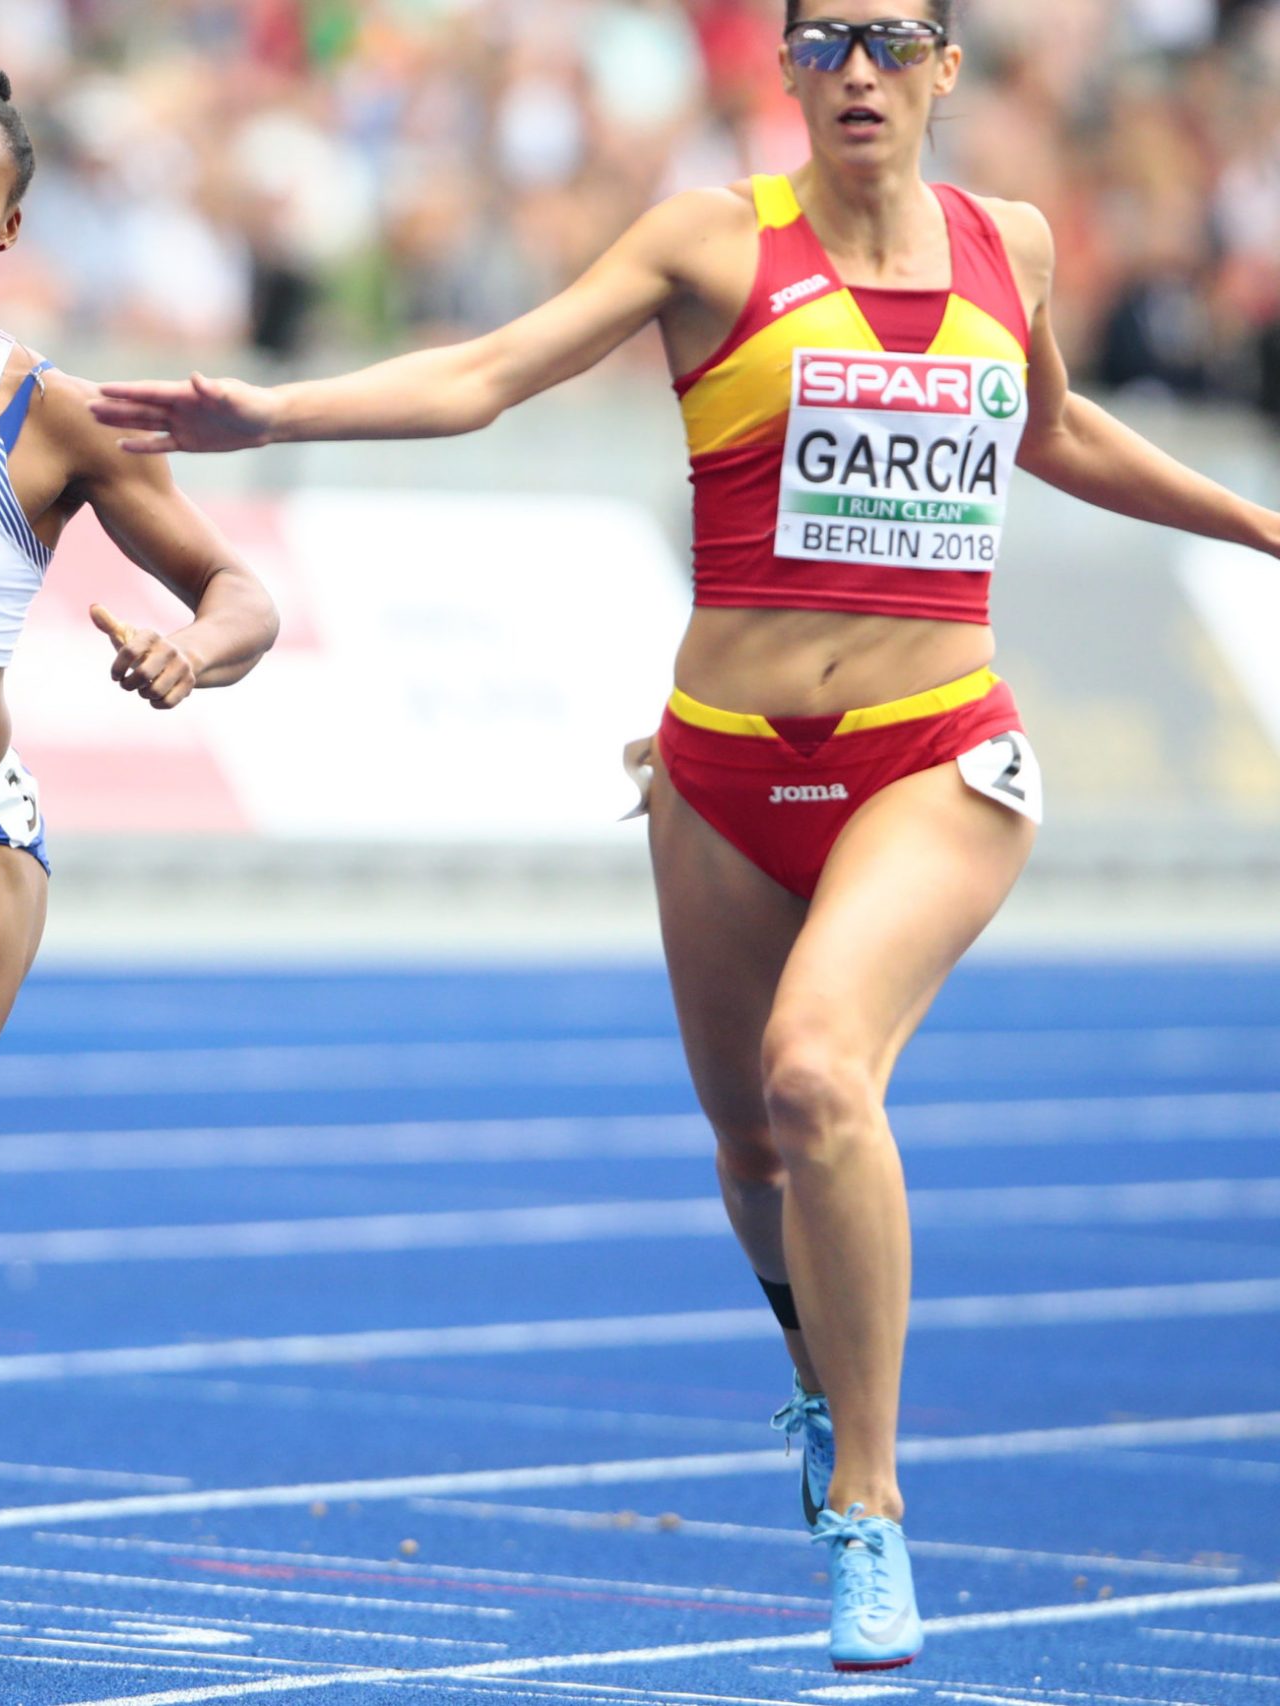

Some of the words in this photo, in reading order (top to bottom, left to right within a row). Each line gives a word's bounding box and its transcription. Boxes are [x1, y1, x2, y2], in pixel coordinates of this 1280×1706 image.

[803, 361, 969, 408] SPAR
[797, 425, 998, 496] GARCÍA
[837, 499, 844, 513] I
[849, 499, 896, 519] RUN
[802, 522, 920, 558] BERLIN
[931, 533, 995, 562] 2018
[990, 731, 1026, 801] 2
